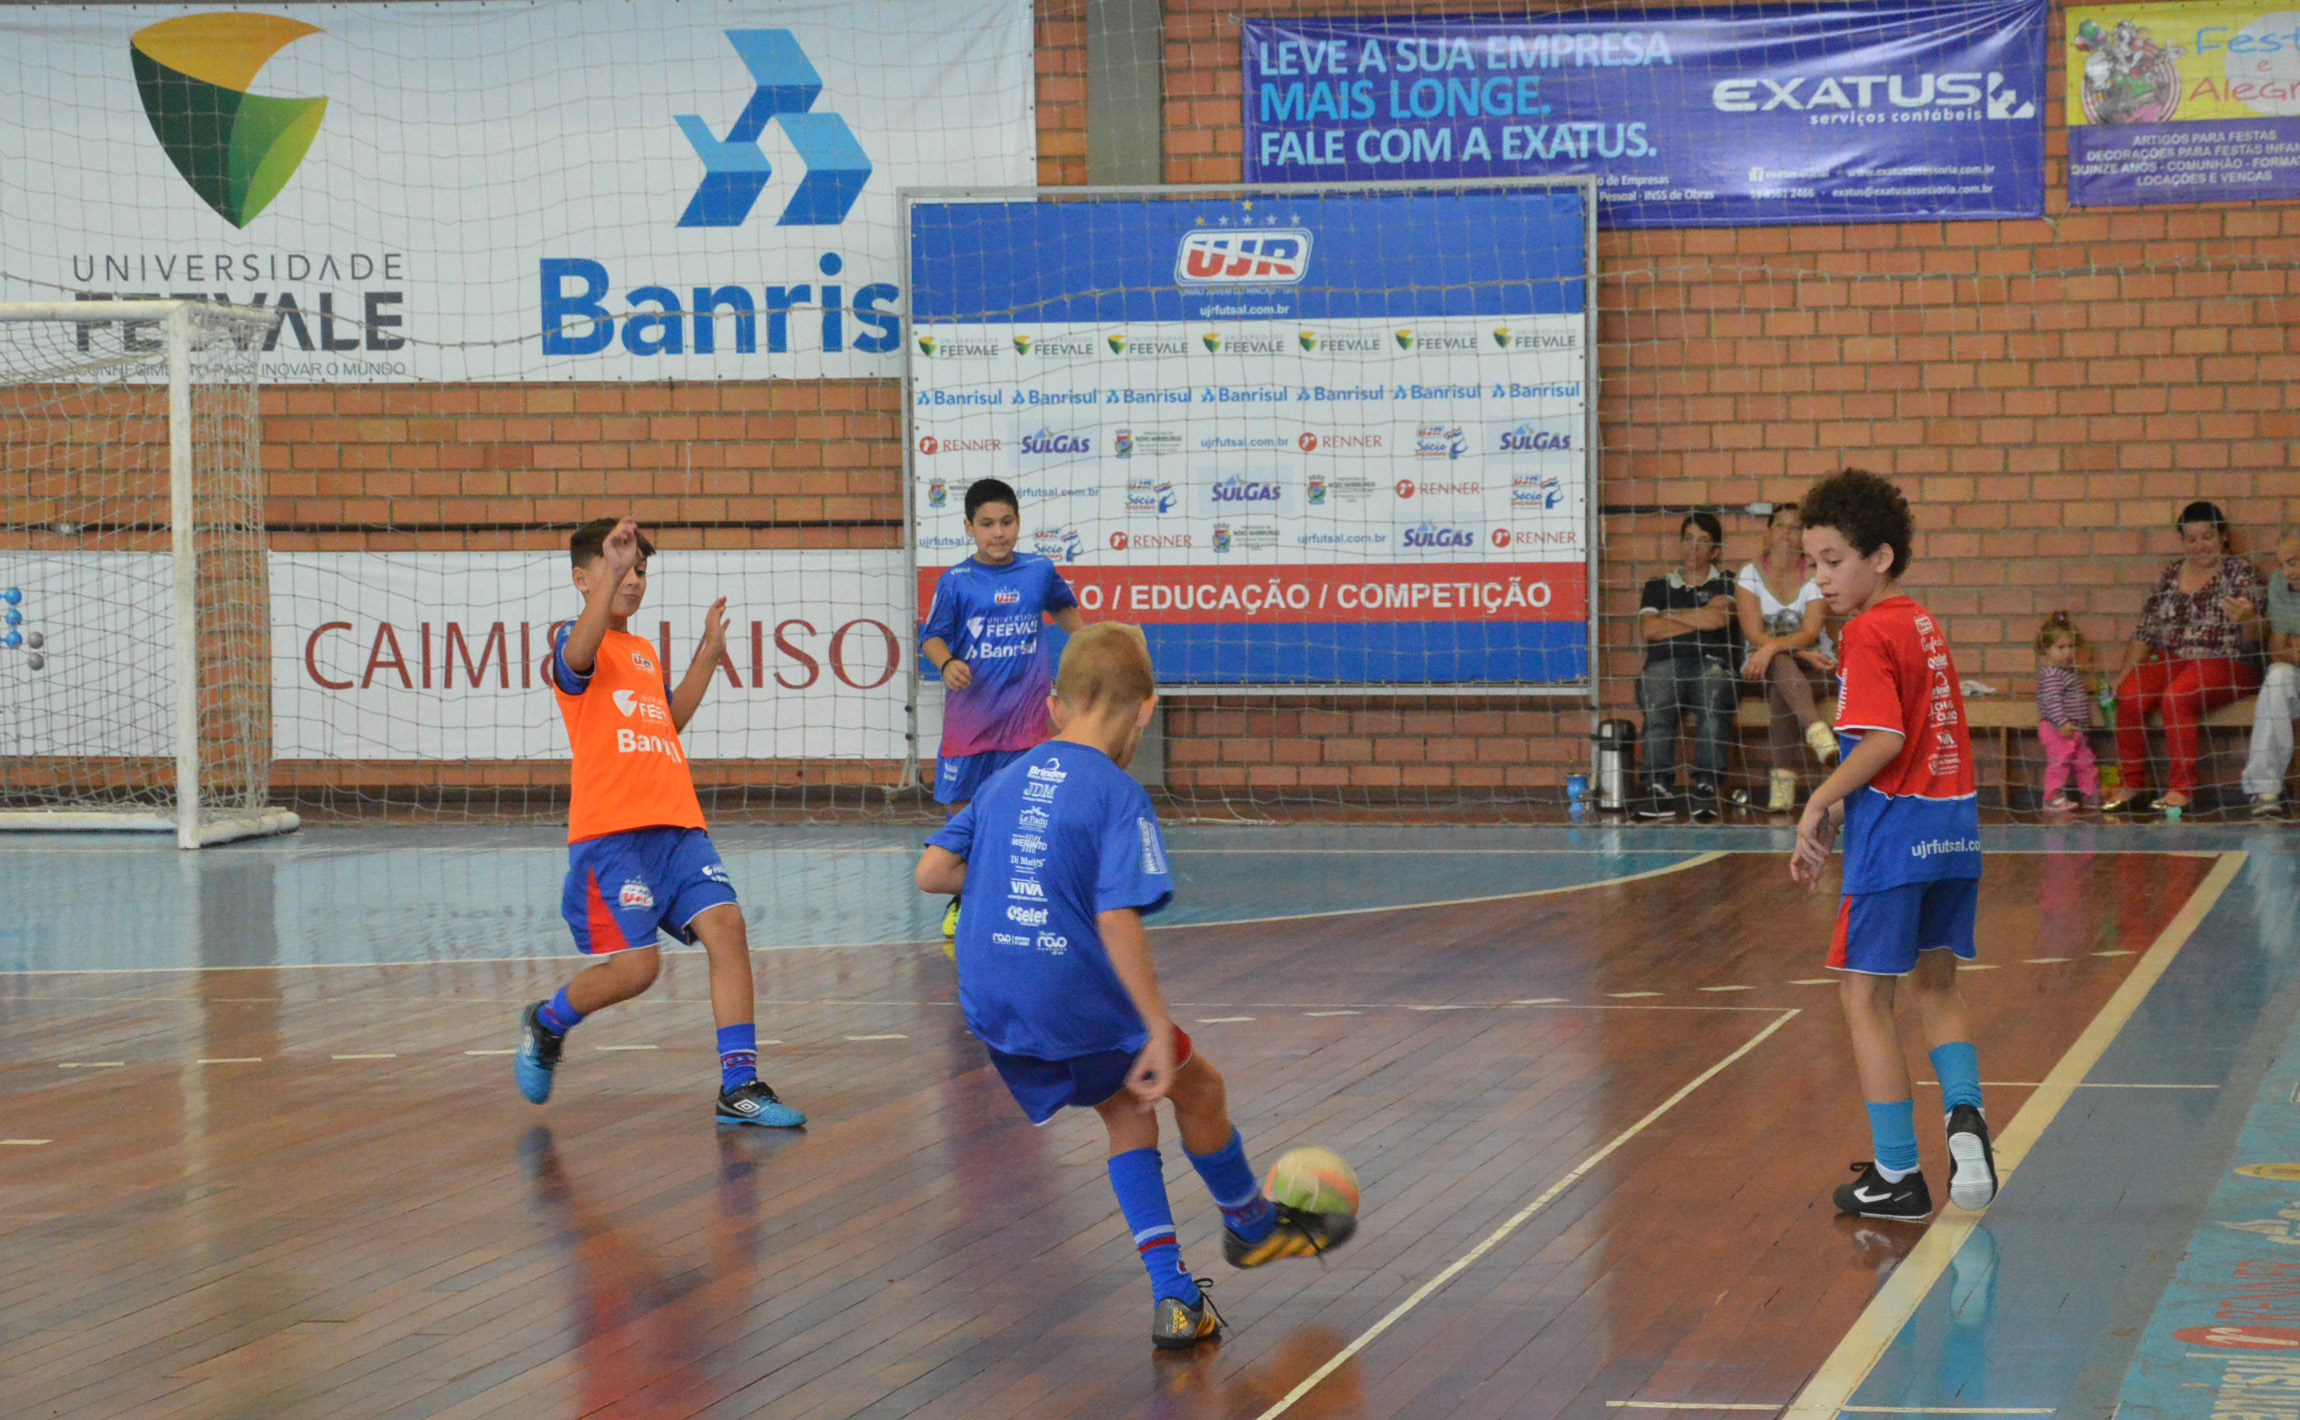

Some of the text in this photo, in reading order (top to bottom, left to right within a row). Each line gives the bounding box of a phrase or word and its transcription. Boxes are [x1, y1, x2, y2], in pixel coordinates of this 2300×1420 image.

[1260, 31, 1672, 76] LEVE A SUA EMPRESA
[1260, 76, 1551, 121] MAIS LONGE.
[1712, 72, 1983, 113] EXATUS
[1809, 105, 1982, 127] serviços contábeis
[1260, 122, 1657, 166] FALE COM A EXATUS.
[2132, 129, 2277, 146] ARTIGOS PARA FESTAS
[2178, 145, 2211, 158] PARA
[2214, 143, 2262, 156] FESTAS
[2071, 163, 2118, 176] QUINZE
[2121, 161, 2157, 174] ANOS
[2167, 157, 2243, 172] COMUNHÃO
[1621, 174, 1670, 188] Empresas
[1187, 239, 1299, 277] UJR
[73, 254, 403, 282] UNIVERSIDADE
[1200, 304, 1290, 317] ujrfutsal.com.br
[940, 335, 1576, 356] FEEVALE FEEVALE FEEVALE FEEVALE FEEVALE FEEVALE FEEVALE
[261, 363, 322, 377] INOVAR
[326, 363, 339, 376] O
[344, 362, 406, 377] MUNDO
[934, 382, 1580, 406] Banrisul Banrisul Banrisul Banrisul Banrisul Banrisul Banrisul
[943, 438, 1002, 452] RENNER
[1201, 436, 1289, 449] ujrfutsal.com.br
[1323, 435, 1382, 448] RENNER
[1420, 482, 1480, 495] RENNER
[1134, 535, 1192, 548] RENNER
[1298, 533, 1386, 546] ujrfutsal.com.br
[1516, 531, 1576, 544] RENNER
[1130, 577, 1309, 615] EDUCAÇÃO
[1337, 577, 1551, 614] COMPETIÇÃO
[1024, 781, 1057, 799] JDM
[1011, 880, 1044, 896] VIVA
